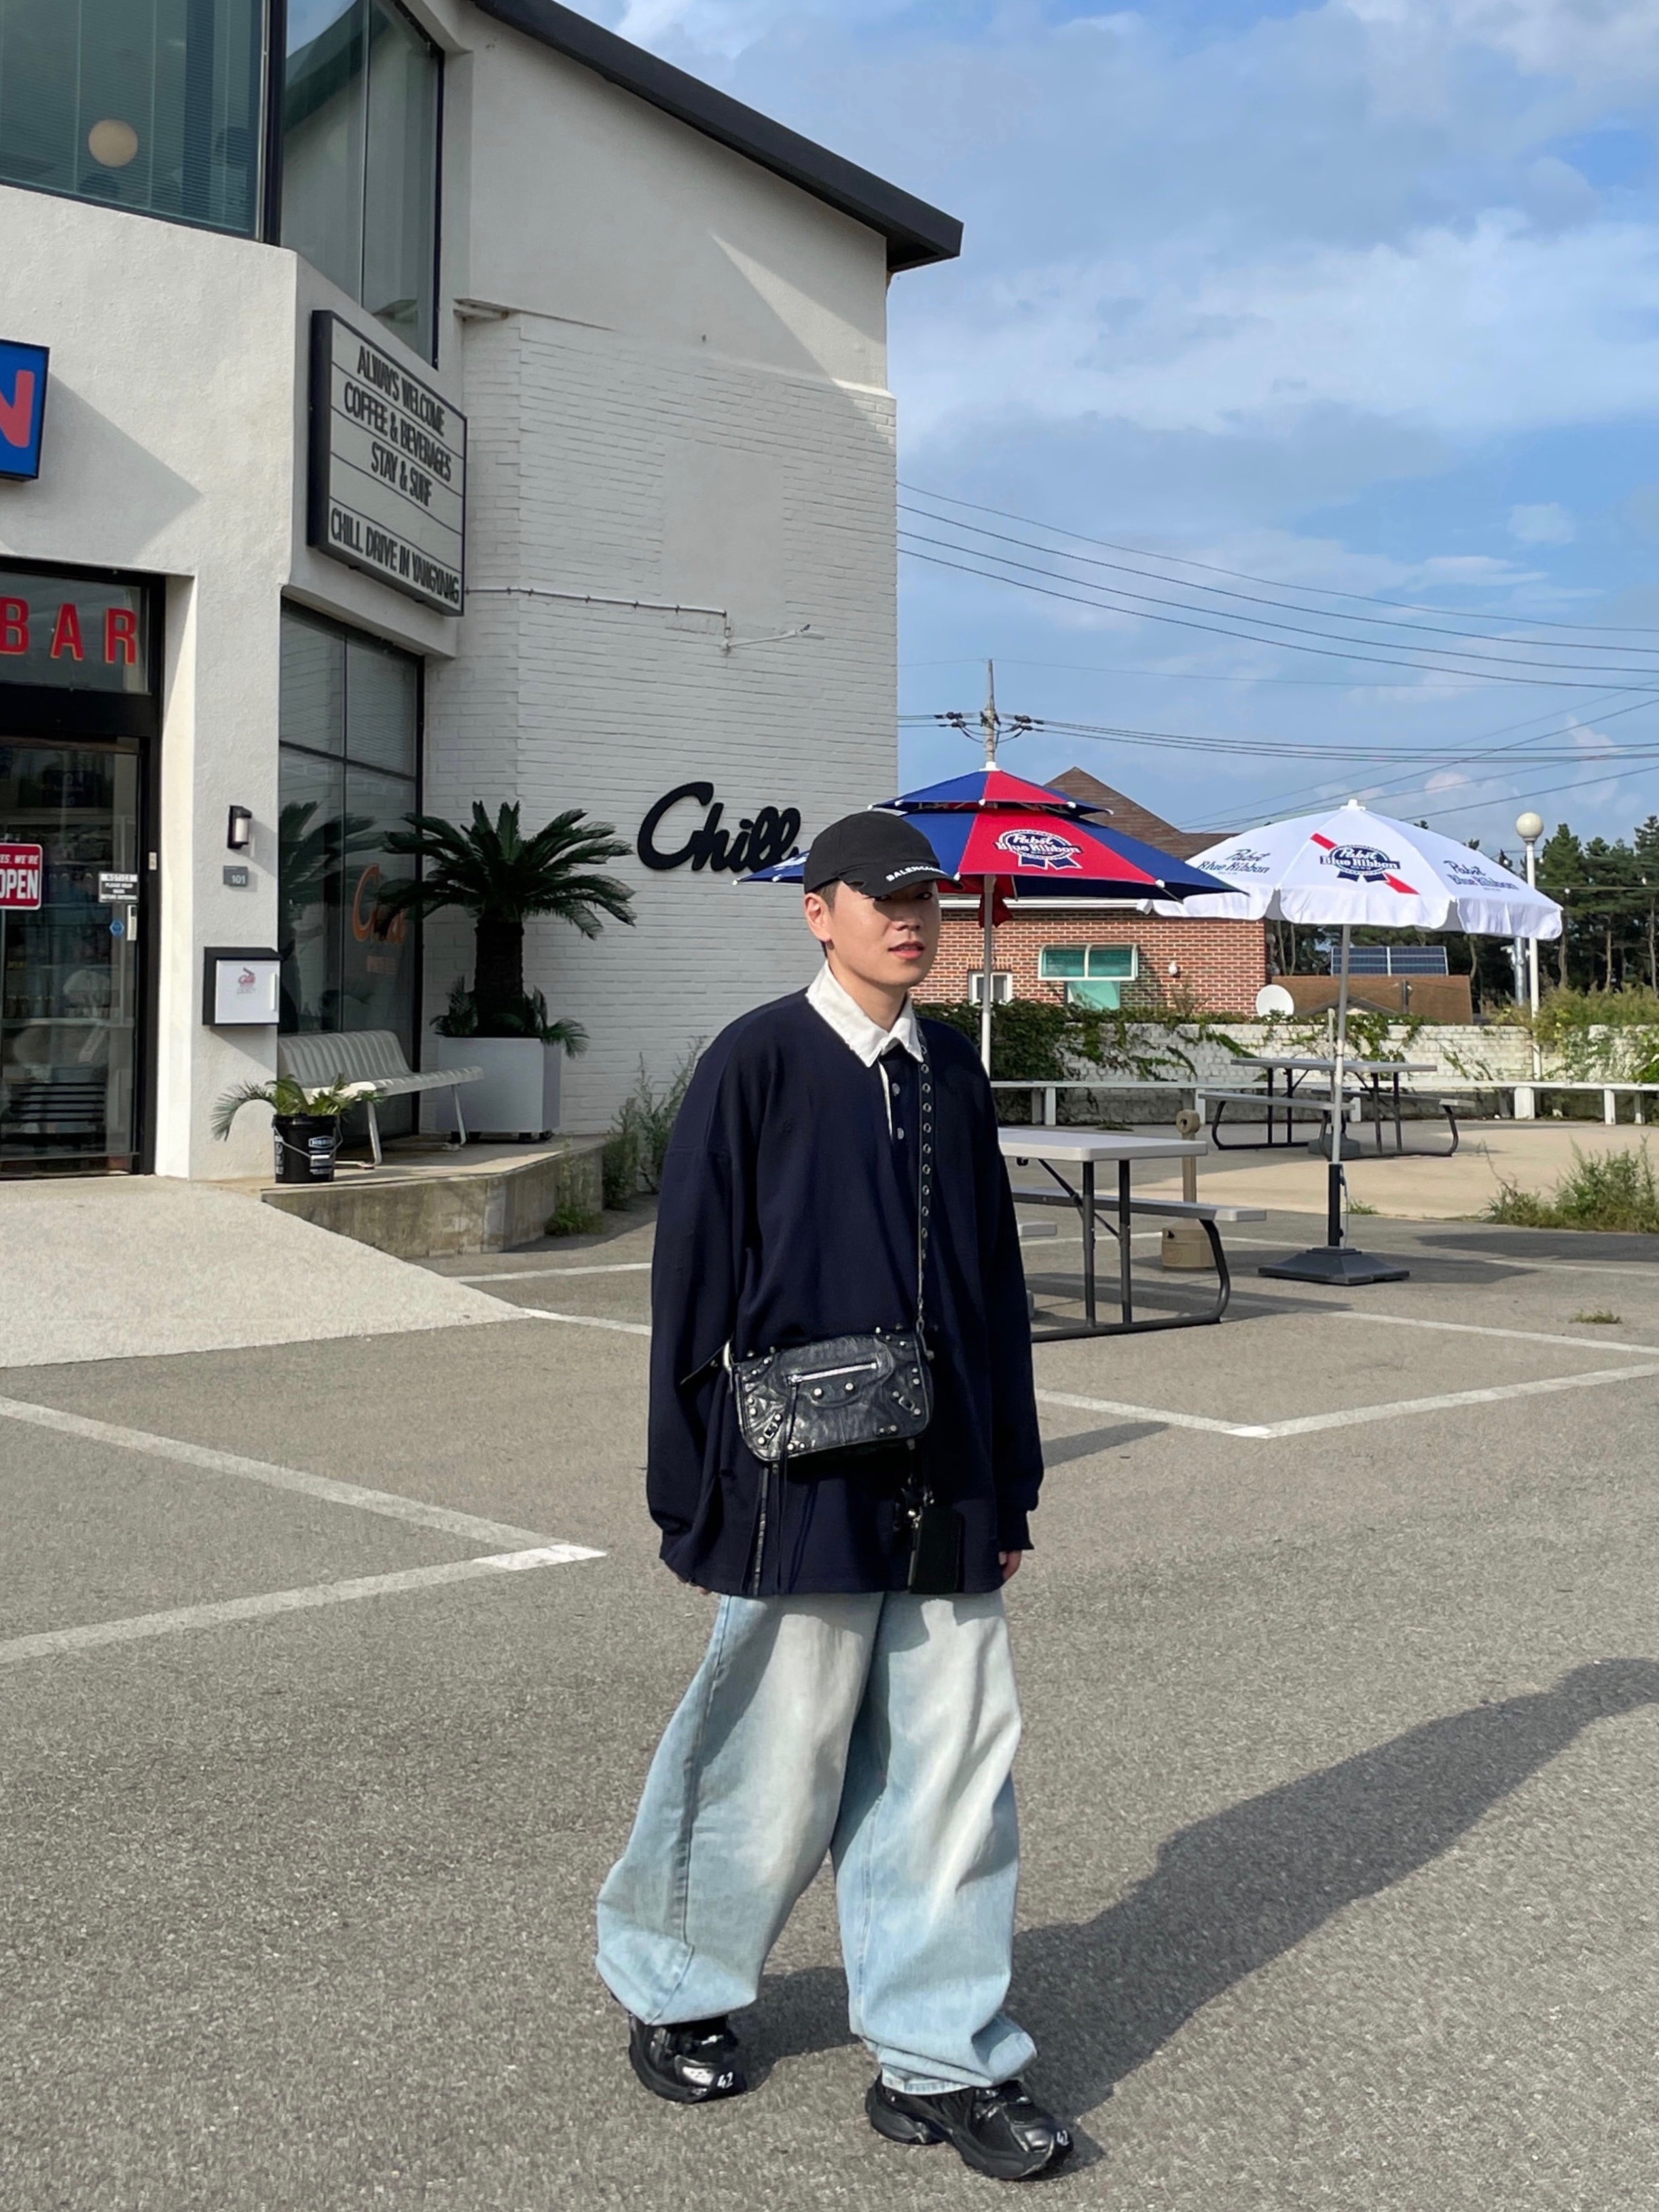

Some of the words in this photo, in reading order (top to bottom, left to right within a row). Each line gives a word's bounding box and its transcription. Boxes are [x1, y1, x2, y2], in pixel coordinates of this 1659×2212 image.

[357, 345, 399, 401] ALWAYS
[401, 377, 445, 437] WELCOME
[344, 381, 388, 436] COFFEE
[390, 412, 399, 444] &
[400, 418, 452, 482] BEVERAGES
[371, 441, 398, 484] STAY
[399, 460, 407, 492] &
[409, 467, 433, 507] SURF
[331, 507, 363, 554] CHILL
[366, 526, 397, 572] DRIVE
[399, 545, 410, 579] IN
[412, 551, 459, 604] YANGYANG
[0, 595, 138, 665] BAR
[638, 781, 801, 873] Chill
[1013, 833, 1054, 845] Pabst
[1029, 843, 1082, 854] Ribbon
[1224, 848, 1271, 862] Pabst
[1339, 847, 1379, 859] Pabst
[1321, 855, 1351, 866] Blue
[1352, 858, 1399, 870] Ribbon
[1443, 860, 1486, 876] Pabst
[232, 874, 246, 884] 101
[717, 2071, 733, 2089] 42
